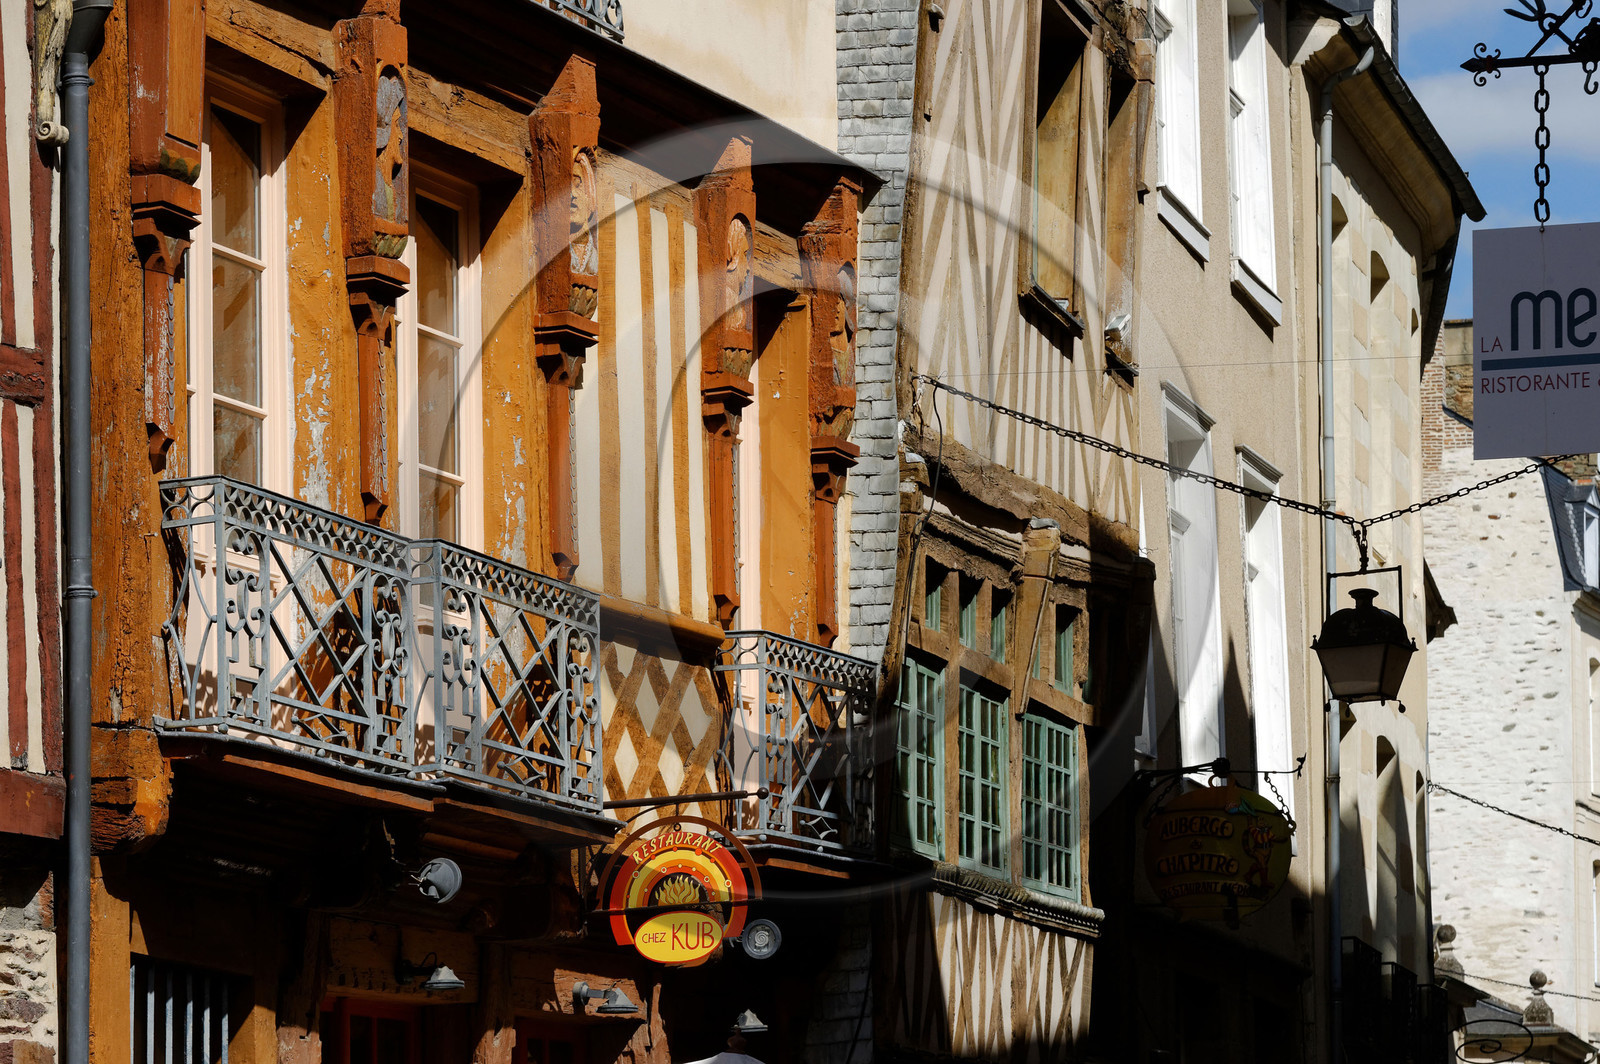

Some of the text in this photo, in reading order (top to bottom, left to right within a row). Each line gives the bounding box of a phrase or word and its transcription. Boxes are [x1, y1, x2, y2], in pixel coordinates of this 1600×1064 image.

[1481, 336, 1504, 353] LA
[1481, 371, 1590, 394] RISTORANTE
[1160, 816, 1234, 840] AUBERGE
[632, 831, 723, 865] RESTAURANT
[1157, 852, 1240, 876] CHAPITRE
[641, 921, 715, 951] CHEZ KUB
